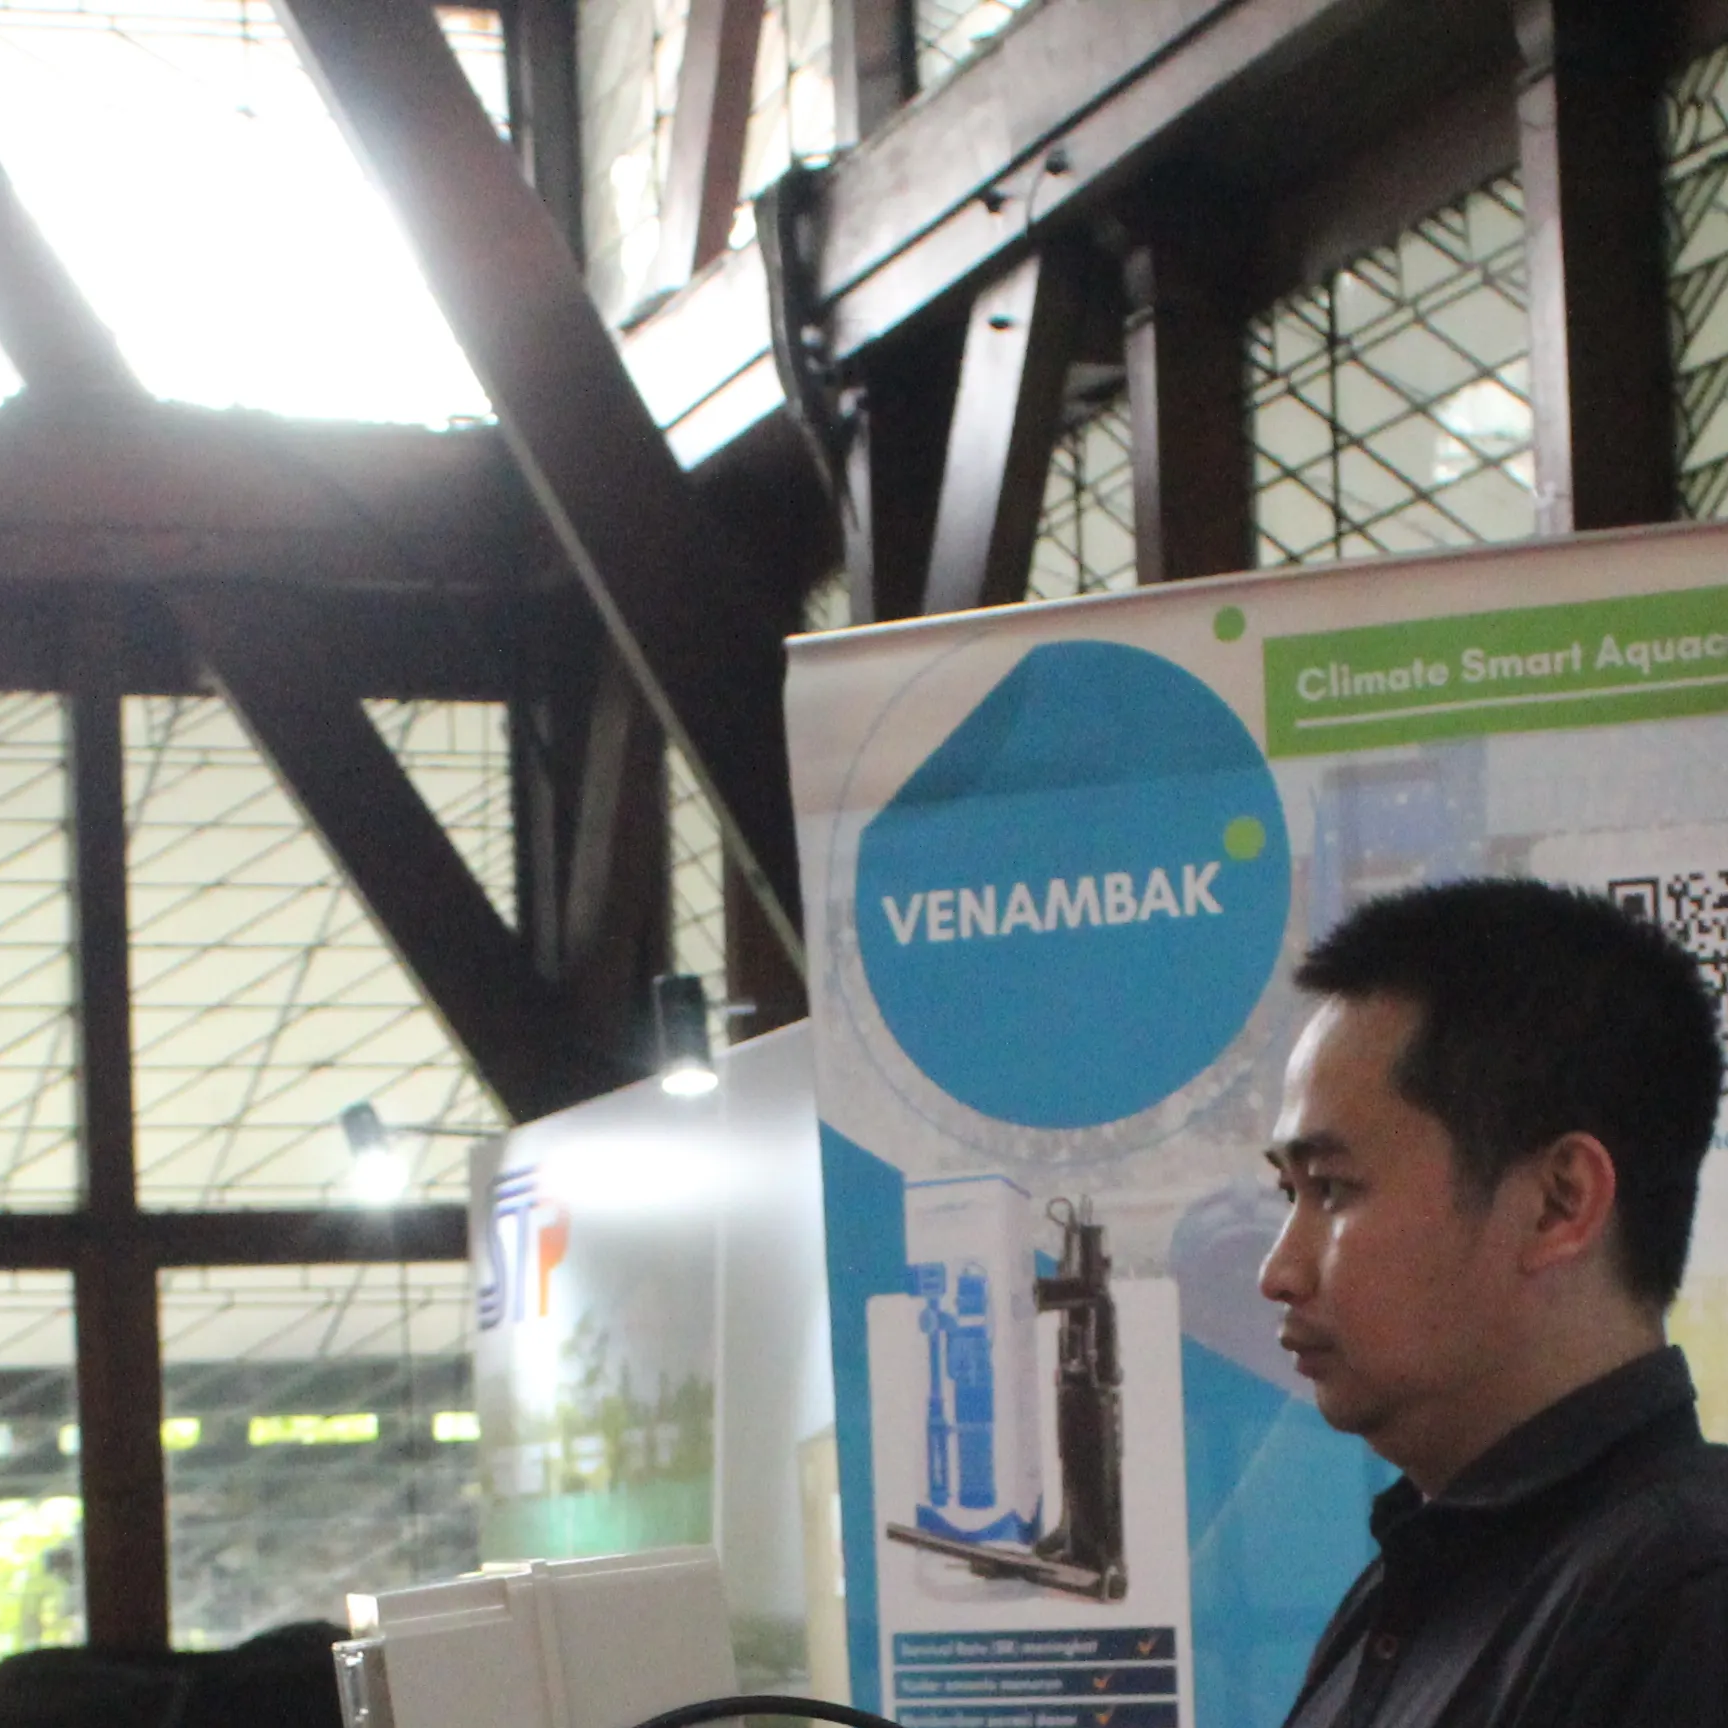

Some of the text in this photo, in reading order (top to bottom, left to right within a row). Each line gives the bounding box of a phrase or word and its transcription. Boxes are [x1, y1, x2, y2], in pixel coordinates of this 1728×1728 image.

[1295, 658, 1449, 703] Climate
[1461, 642, 1583, 684] Smart
[882, 861, 1224, 946] VENAMBAK
